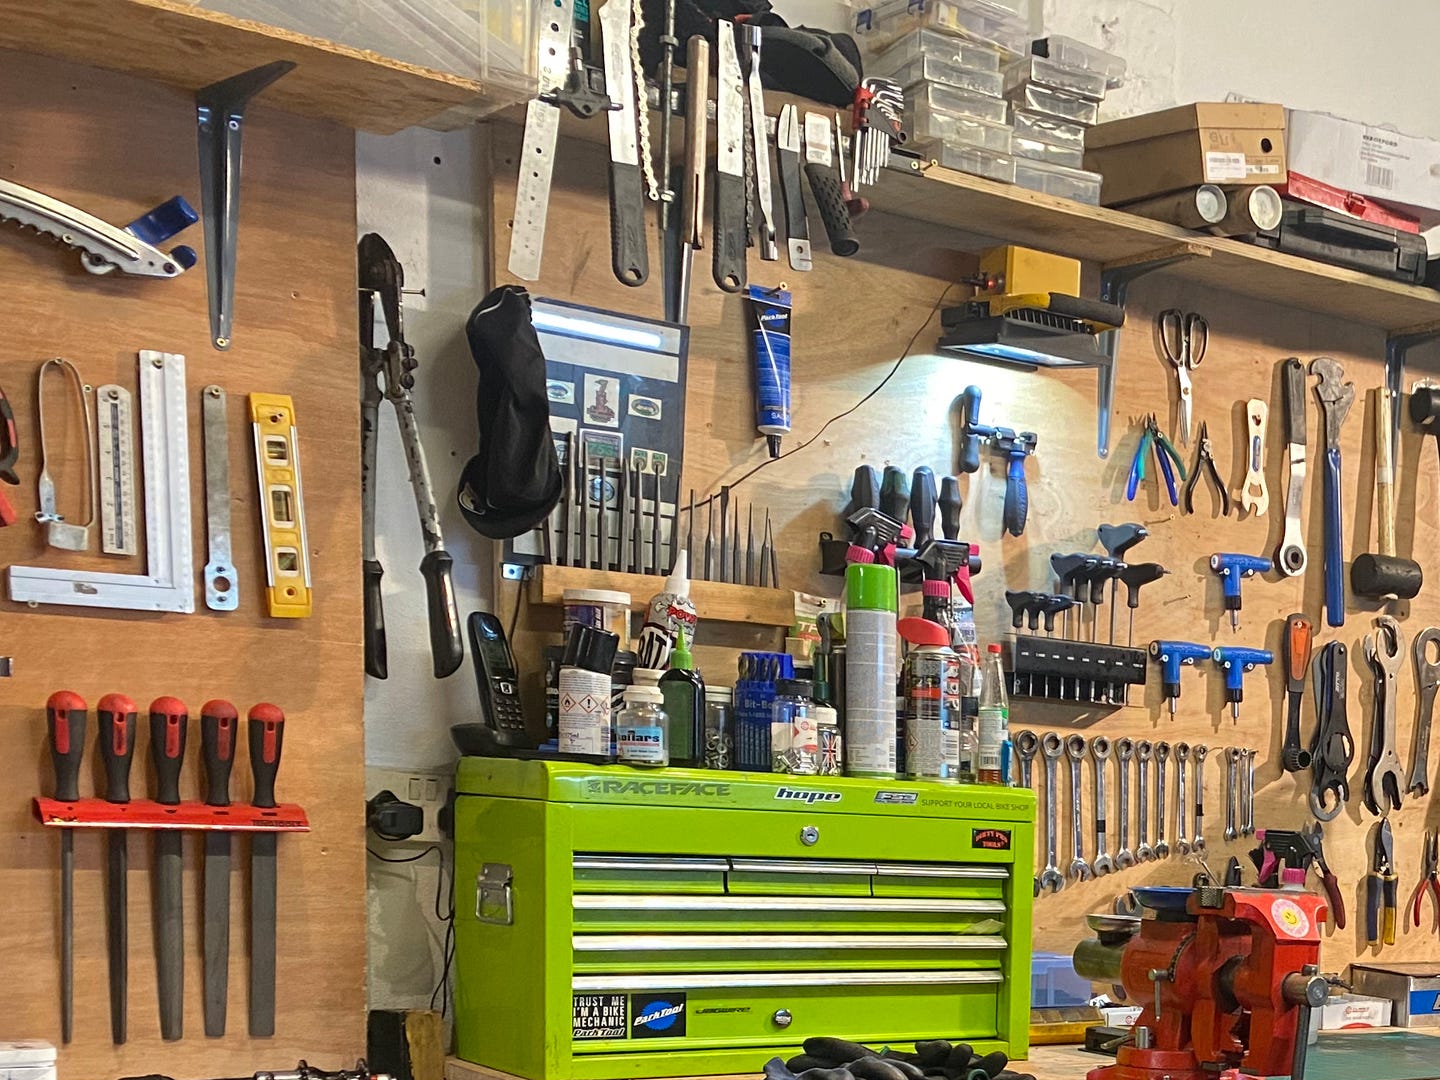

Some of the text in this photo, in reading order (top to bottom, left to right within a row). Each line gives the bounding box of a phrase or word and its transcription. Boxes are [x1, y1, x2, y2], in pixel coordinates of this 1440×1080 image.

[777, 788, 841, 803] hope
[954, 801, 972, 809] YOUR
[974, 802, 995, 810] LOCAL
[996, 803, 1009, 811] BIKE
[573, 996, 625, 1007] TRUST ME
[573, 1006, 625, 1017] I'M A BIKE
[573, 1016, 625, 1028] MECHANIC
